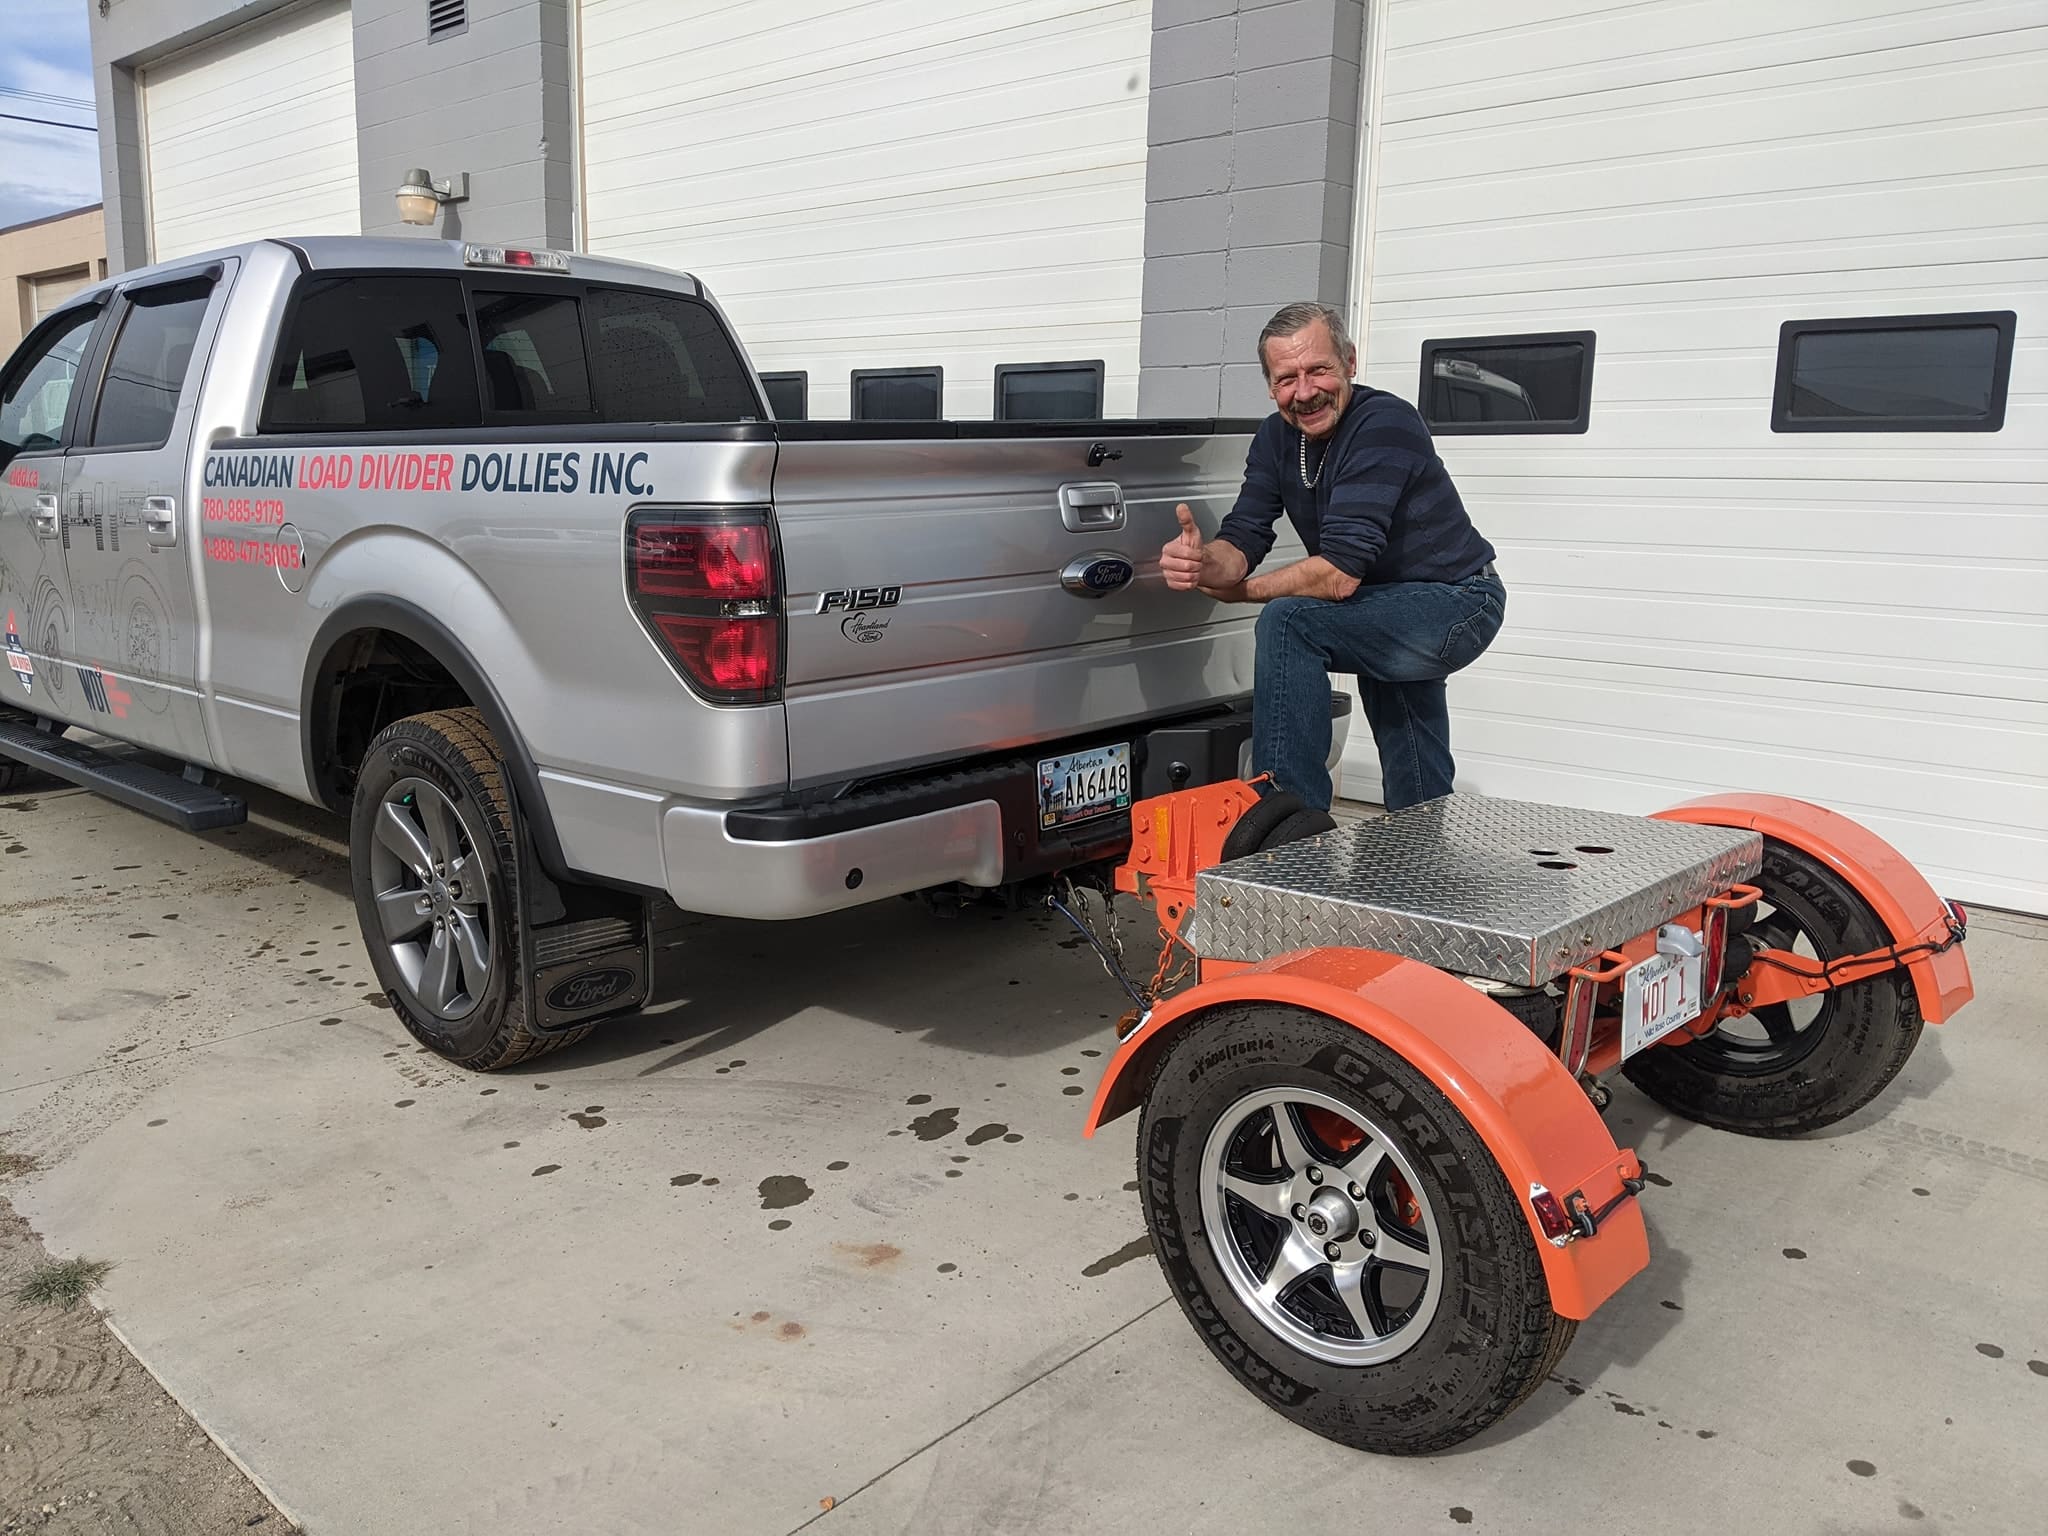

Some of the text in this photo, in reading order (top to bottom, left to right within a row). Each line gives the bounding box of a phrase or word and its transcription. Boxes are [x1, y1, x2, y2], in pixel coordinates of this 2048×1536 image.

[204, 451, 655, 496] CANADIAN LOAD DIVIDER DOLLIES INC.
[203, 498, 284, 524] 780-885-9179
[1095, 564, 1125, 584] Ford
[815, 586, 903, 615] F-150
[1065, 763, 1128, 807] AA6448
[564, 974, 618, 1006] Ford
[1642, 966, 1686, 1027] WDT 1
[1149, 1143, 1181, 1259] TRAIL
